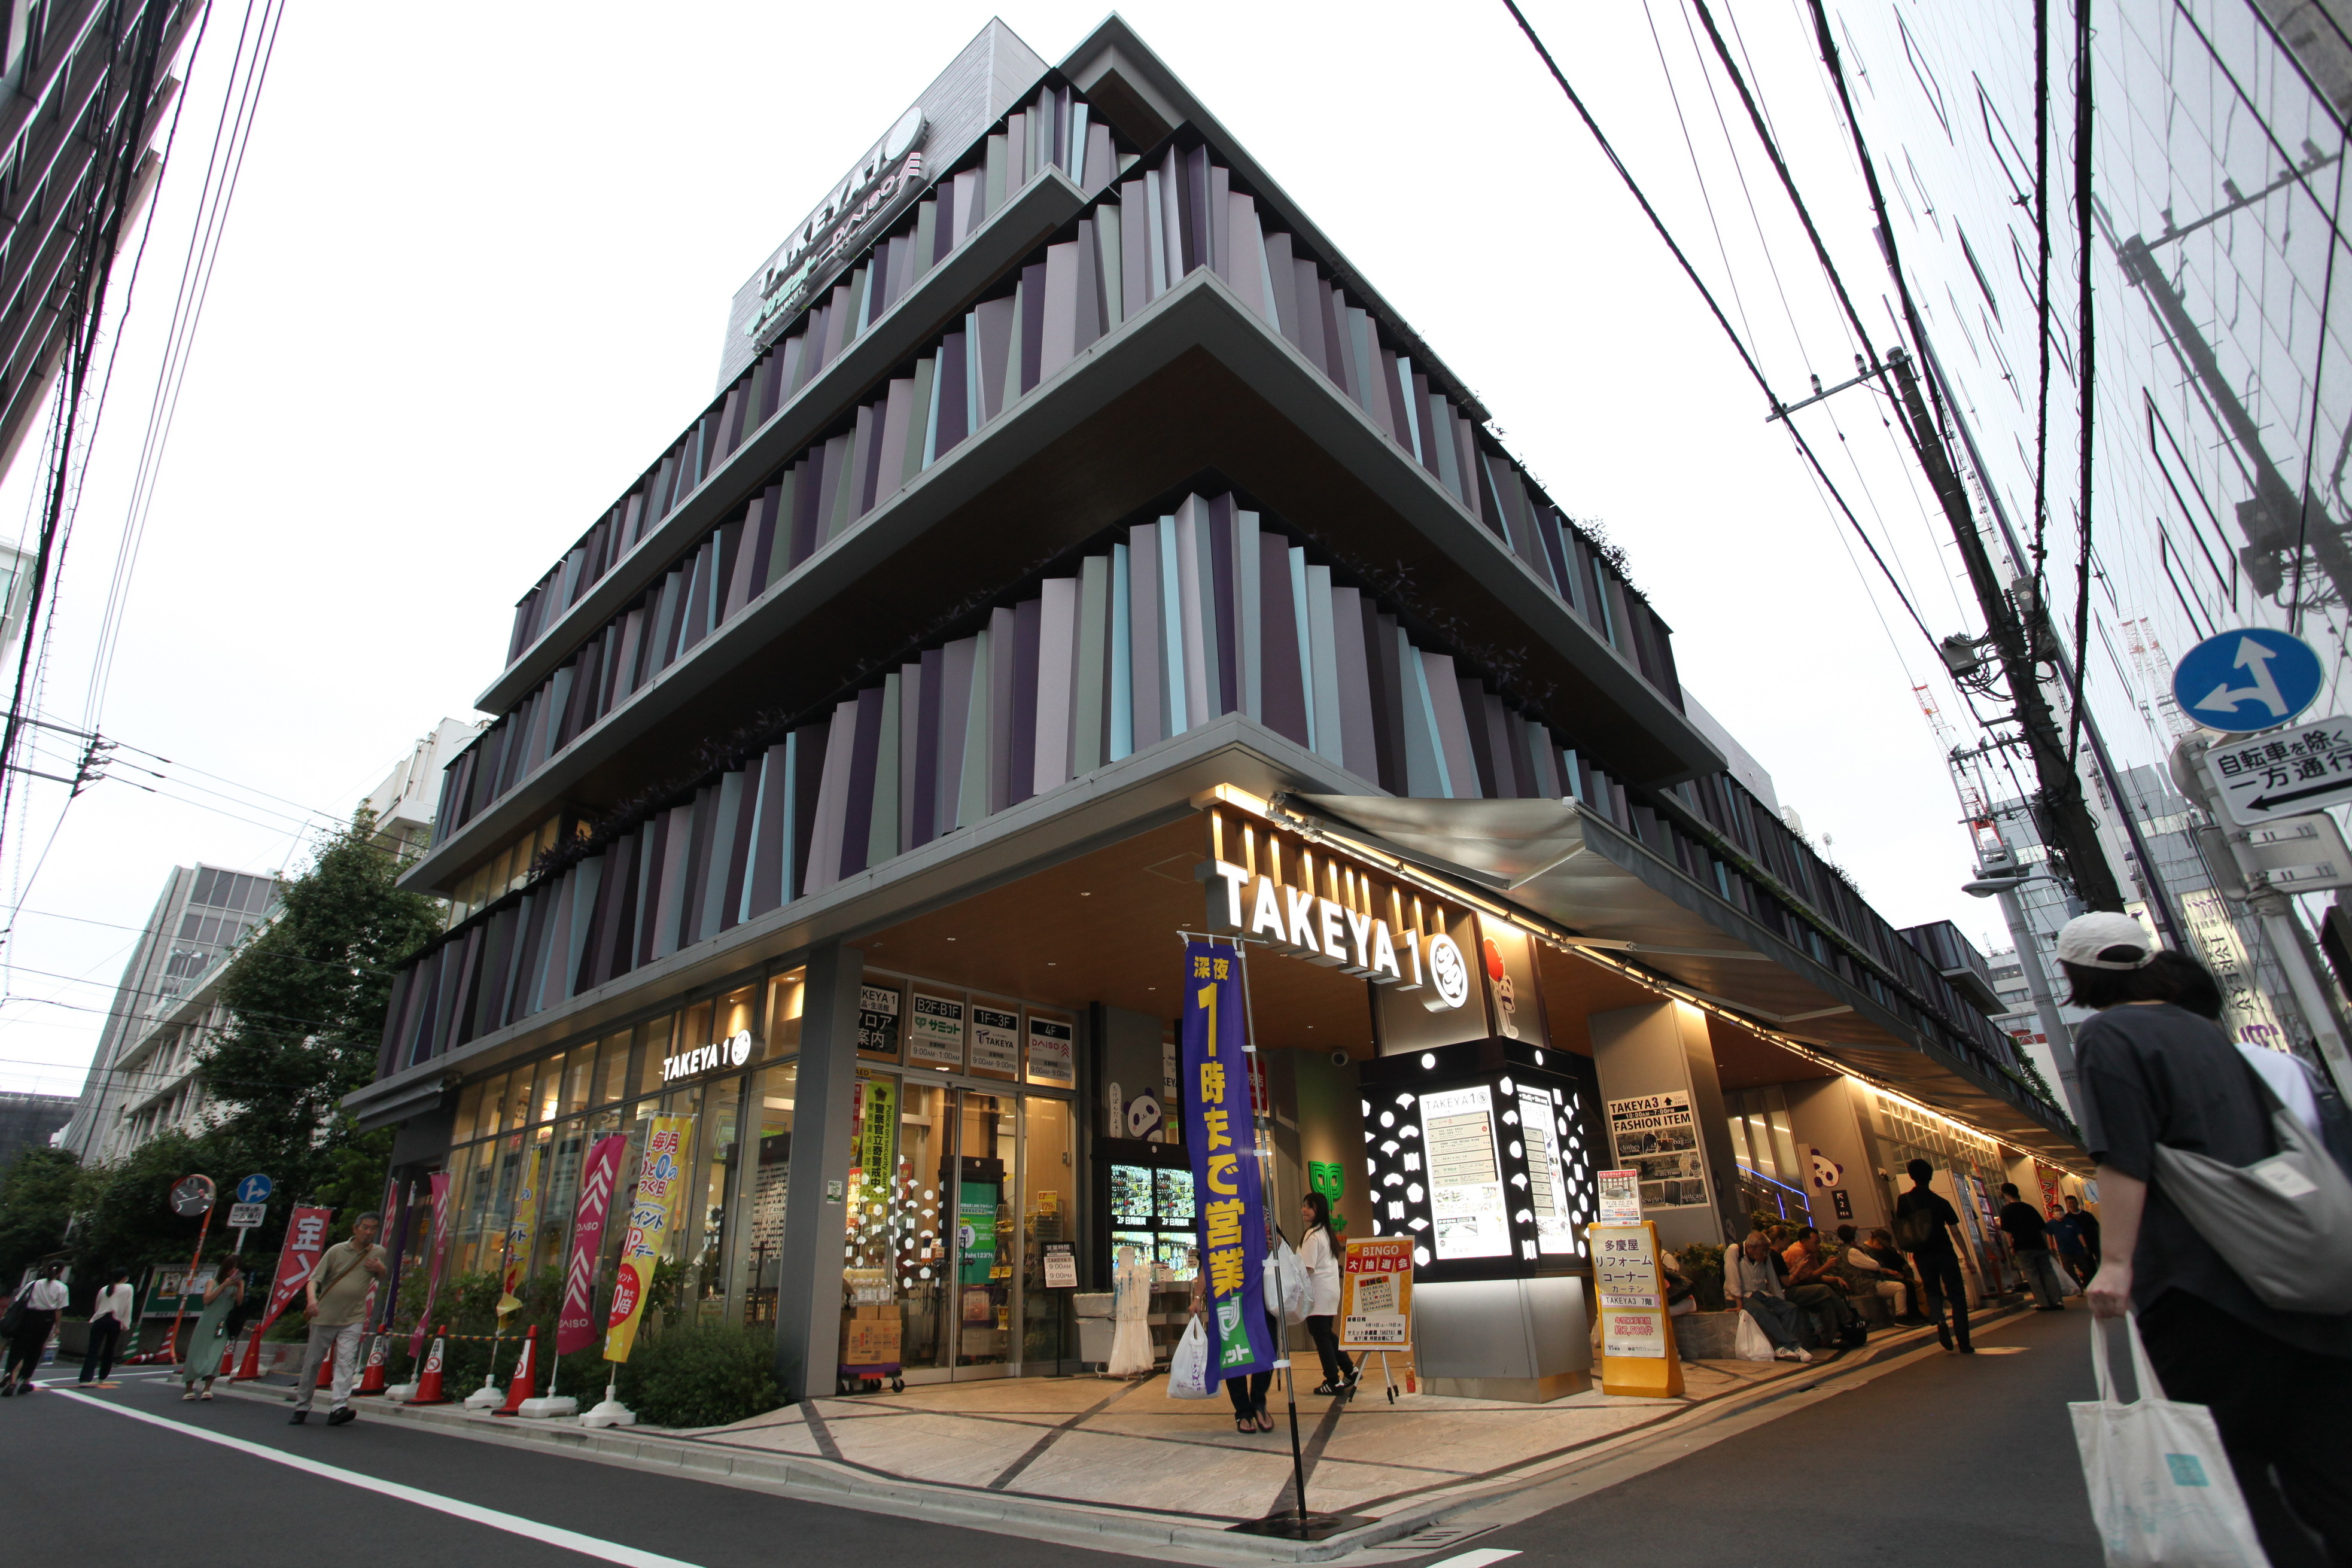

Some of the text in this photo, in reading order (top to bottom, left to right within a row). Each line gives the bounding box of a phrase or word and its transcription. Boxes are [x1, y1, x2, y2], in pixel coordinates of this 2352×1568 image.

[832, 175, 896, 248] DAISO
[757, 166, 866, 297] TAKEYA
[2217, 730, 2349, 775] 自転車を除く
[2229, 747, 2352, 789] 一方通行
[1216, 860, 1401, 984] TAKEYA
[1194, 956, 1229, 981] 深夜
[862, 989, 889, 1003] KEYA
[861, 1000, 889, 1012] 品・生活館
[929, 1019, 961, 1035] サミット
[1045, 1024, 1056, 1036] 4F
[858, 1028, 884, 1048] 案内
[986, 1037, 1014, 1049] TAKEYA
[1032, 1039, 1059, 1050] DAISO
[664, 1038, 729, 1082] TAKEYA 1
[1614, 1113, 1691, 1132] FASHION ITEM
[886, 1128, 890, 1138] on
[651, 1130, 680, 1155] 毎月
[1197, 982, 1245, 1299] 1時まで営業
[639, 1179, 668, 1198] つく日
[1117, 1216, 1124, 1224] 2F
[576, 1222, 598, 1232] DAISO
[1362, 1245, 1399, 1256] BINGO
[1605, 1239, 1639, 1252] 多慶屋
[1349, 1258, 1408, 1270] 大抽選会
[1596, 1255, 1653, 1267] リフォーム
[1360, 1277, 1389, 1287] BINGO
[1604, 1271, 1648, 1283] コーナー
[1615, 1317, 1651, 1325] 年間工事実績
[1614, 1326, 1653, 1335] 約2,500件
